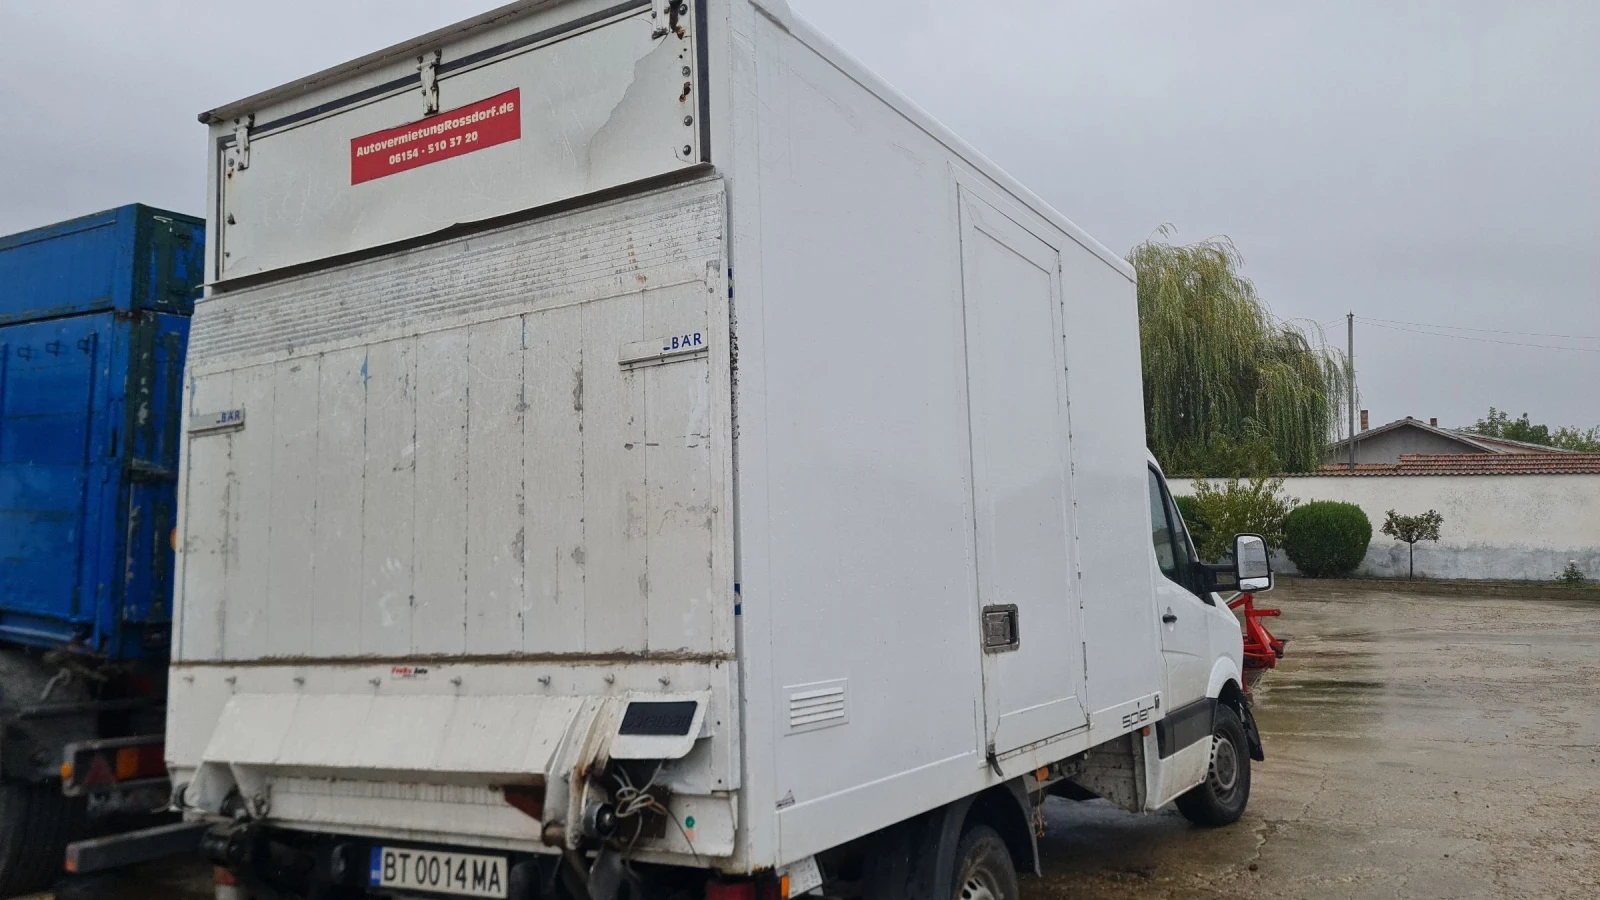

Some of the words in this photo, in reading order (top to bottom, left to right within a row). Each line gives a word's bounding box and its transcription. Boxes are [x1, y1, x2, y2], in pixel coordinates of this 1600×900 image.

[356, 102, 514, 157] AutovermietungRossdorf.de
[389, 149, 419, 165] 06154
[428, 140, 447, 154] 510
[449, 135, 462, 148] 37
[465, 131, 479, 143] 20
[672, 332, 702, 350] BÄR
